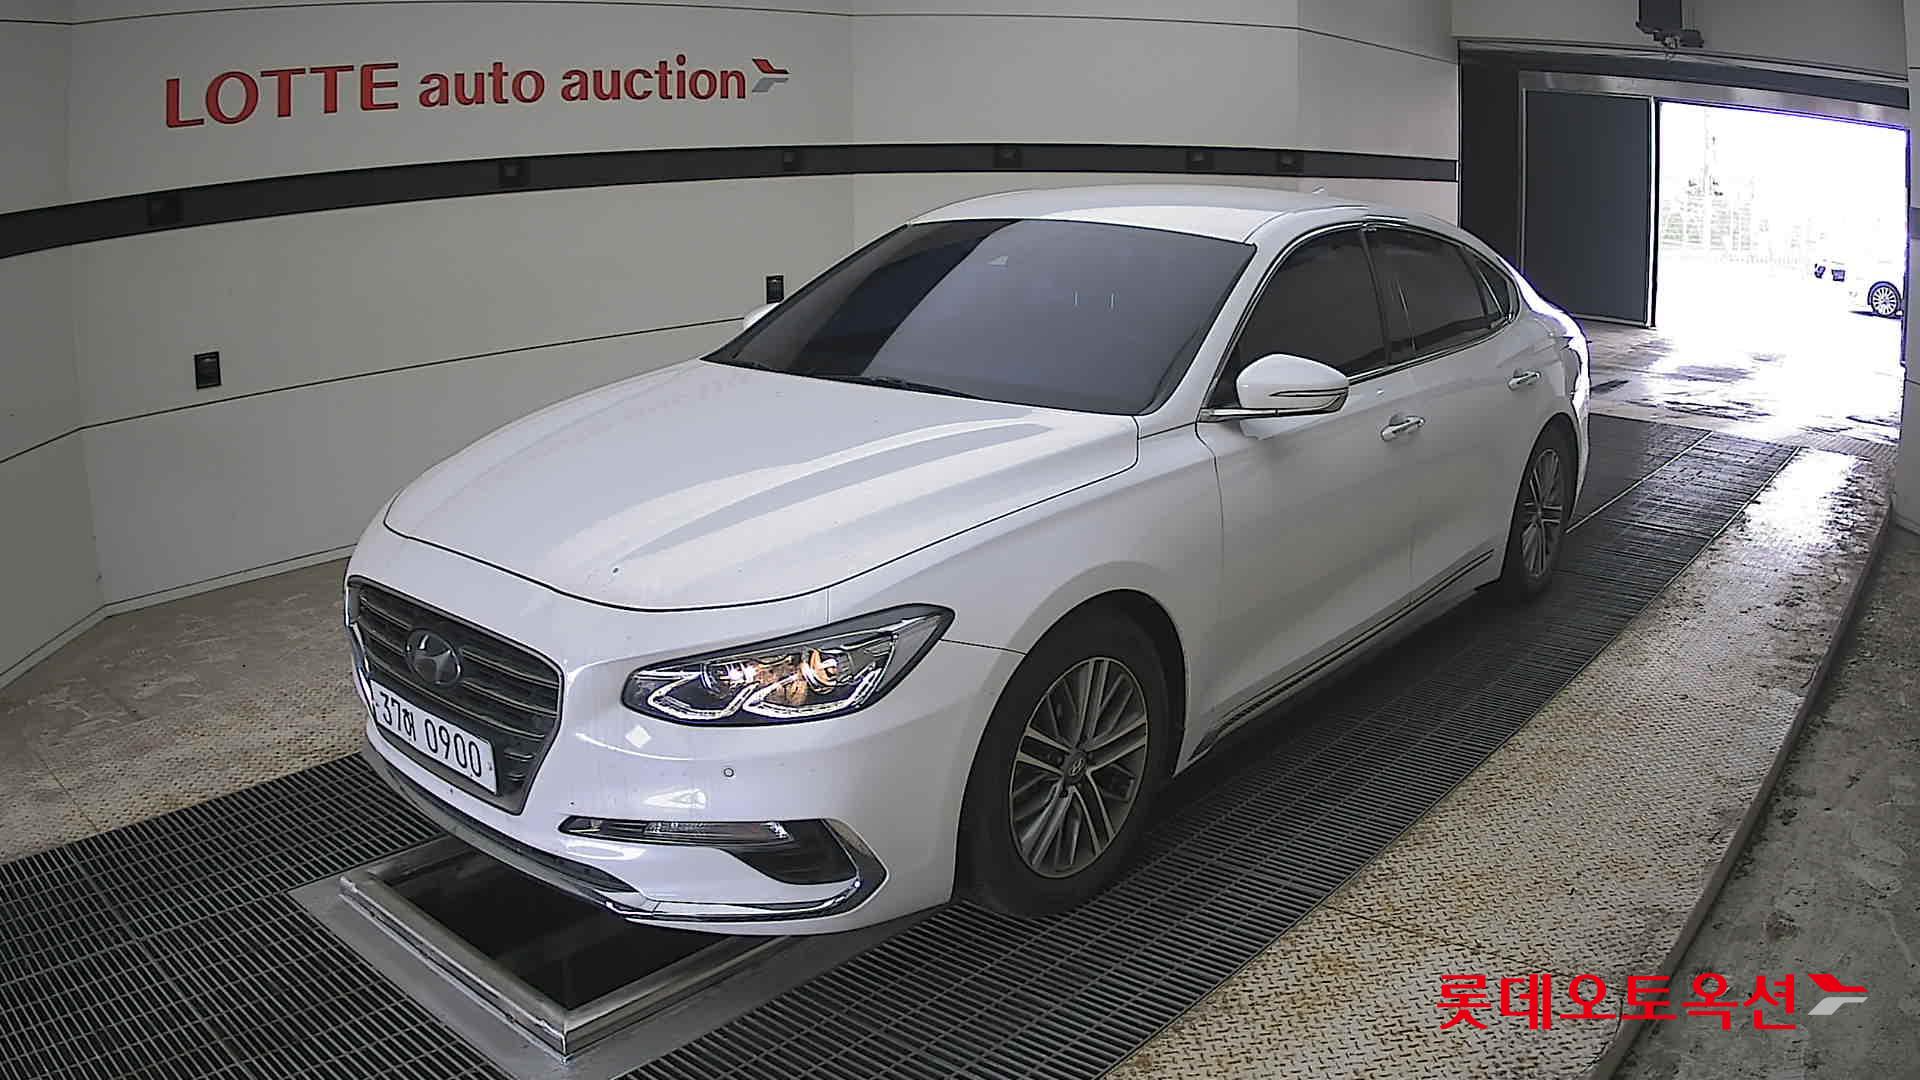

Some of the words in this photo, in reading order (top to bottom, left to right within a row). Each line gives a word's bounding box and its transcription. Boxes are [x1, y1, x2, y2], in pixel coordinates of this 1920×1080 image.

[165, 62, 399, 128] LOTTE
[418, 62, 546, 108] auto
[560, 55, 747, 102] auction
[379, 691, 417, 741] 37허
[424, 718, 482, 778] 0900
